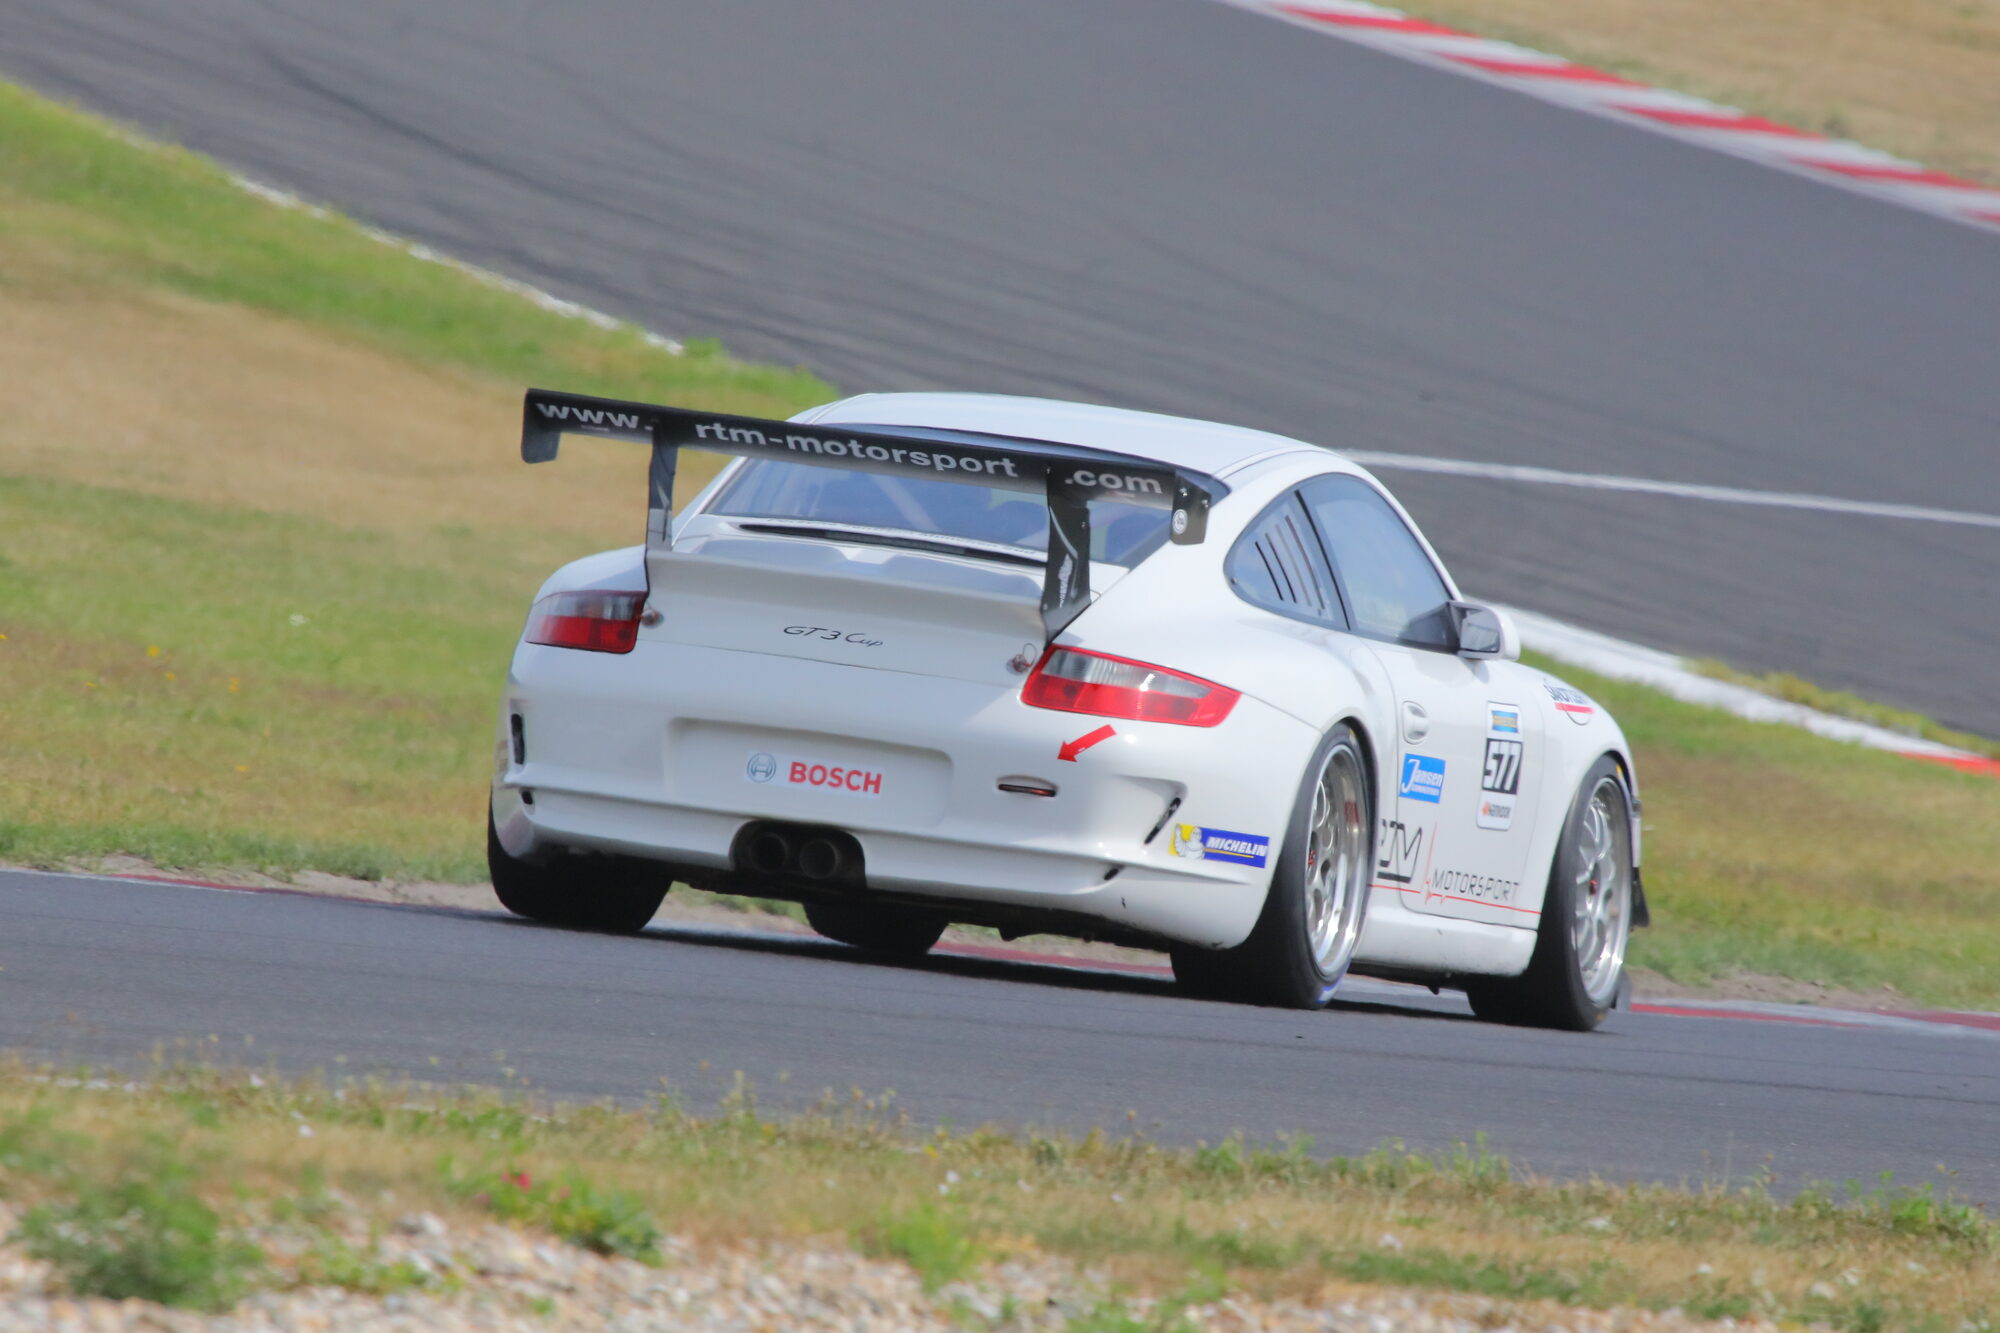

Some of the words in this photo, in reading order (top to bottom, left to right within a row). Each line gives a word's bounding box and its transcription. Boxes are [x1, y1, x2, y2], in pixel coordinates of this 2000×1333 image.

[536, 402, 654, 431] www.
[695, 422, 1018, 478] rtm-motorsport
[1064, 470, 1163, 494] .com
[783, 625, 841, 641] GT3
[845, 633, 883, 647] Cup
[788, 761, 882, 794] BOSCH
[1482, 740, 1521, 792] 577
[1205, 836, 1269, 857] MICHELIN
[1431, 869, 1519, 902] MOTORSPORT
